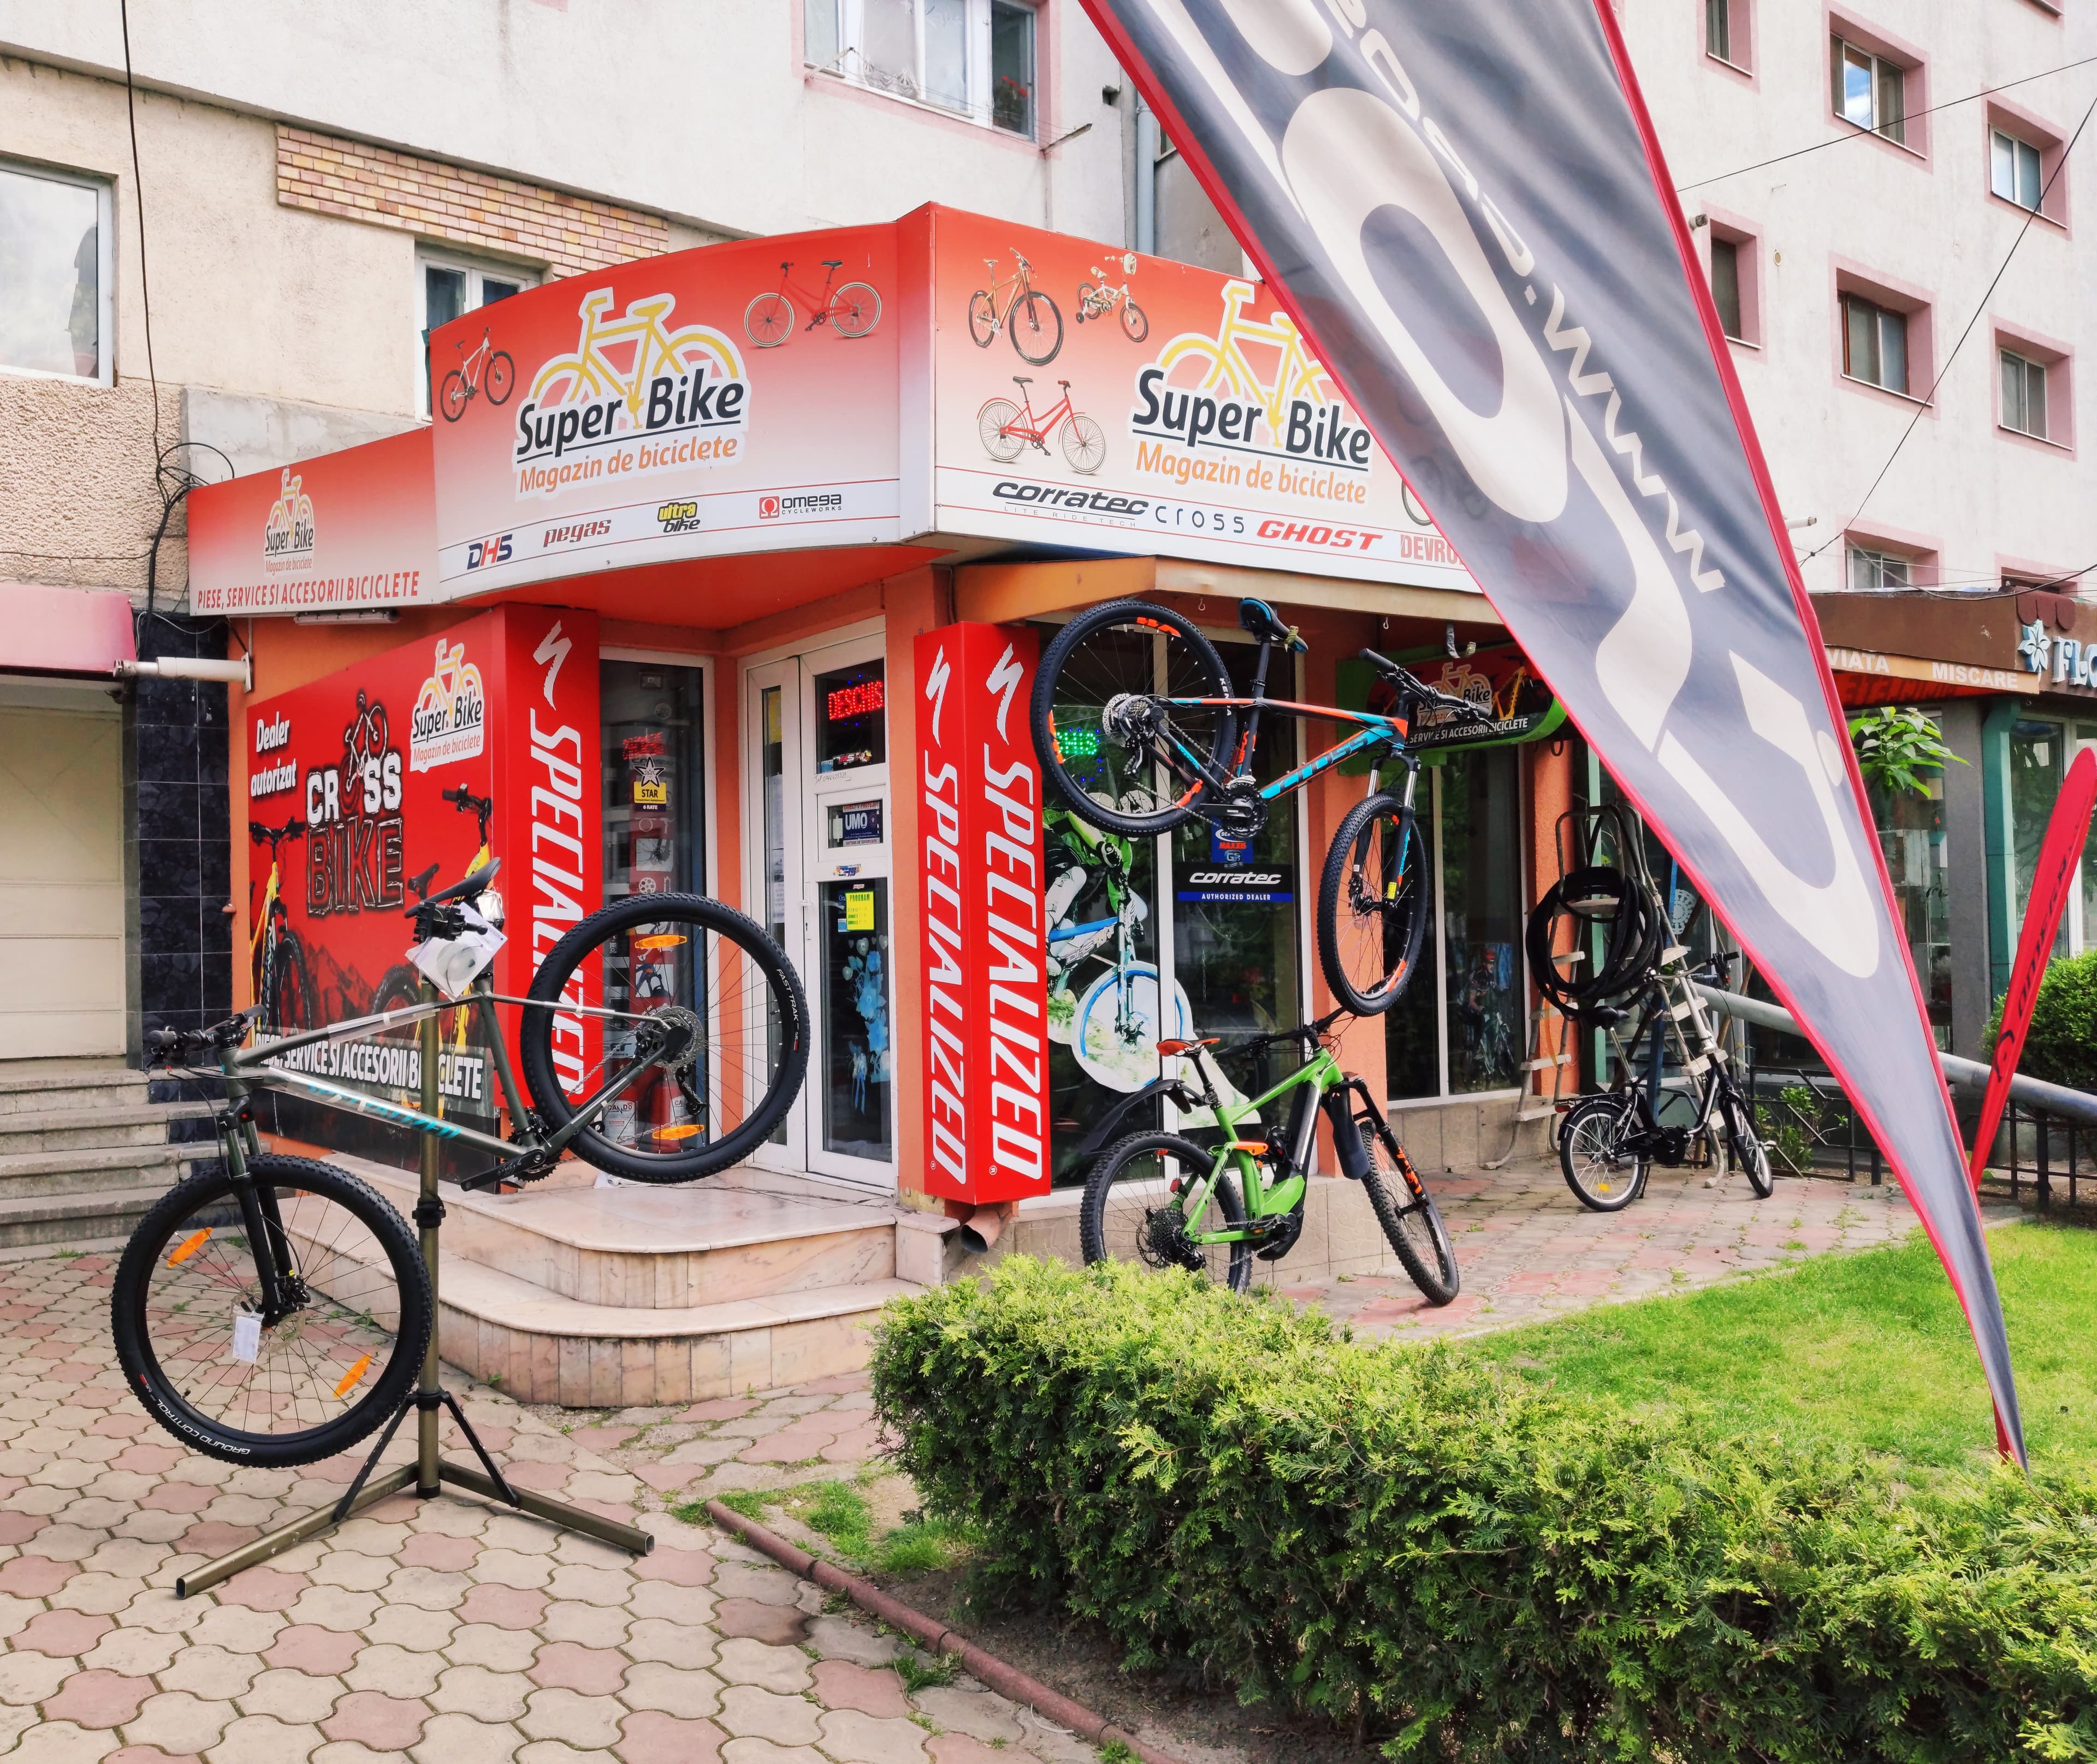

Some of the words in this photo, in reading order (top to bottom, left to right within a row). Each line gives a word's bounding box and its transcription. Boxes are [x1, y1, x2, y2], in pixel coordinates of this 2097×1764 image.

[517, 400, 622, 458] Super
[646, 368, 744, 430] Bike
[1133, 369, 1263, 447] Super
[1284, 400, 1371, 464] Bike
[520, 458, 600, 494] Magazin
[608, 448, 632, 474] de
[639, 436, 737, 468] biciclete
[1136, 441, 1241, 485] Magazin
[1246, 455, 1272, 490] de
[1278, 458, 1367, 504] biciclete
[657, 502, 698, 522] ultra
[782, 493, 842, 509] omega
[782, 506, 843, 515] CYCLEWORKS
[992, 482, 1150, 515] corratec
[543, 519, 612, 548] pegas
[663, 518, 701, 533] bike
[1004, 506, 1039, 515] LITE
[1053, 512, 1088, 522] RIDE
[1099, 518, 1136, 528] TECH
[265, 525, 289, 557] Super
[294, 521, 313, 550] Bike
[466, 533, 513, 571] DHS
[1257, 520, 1384, 550] GHOST
[1401, 534, 1464, 565] DEVRO
[265, 559, 285, 576] Magazin
[286, 557, 292, 571] de
[292, 557, 312, 570] biciclete
[198, 589, 224, 609] PIESE,
[227, 585, 266, 608] SERVICE
[270, 584, 279, 605] SI
[282, 578, 343, 604] ACCESORII
[347, 571, 419, 601] BICICLETE
[1932, 661, 2018, 689] MISCARE
[828, 680, 884, 720] DESCHIS
[1219, 678, 1231, 716] KENA
[1463, 684, 1490, 703] Bike
[256, 711, 290, 753] Dealer
[413, 707, 447, 743] Super
[454, 691, 482, 728] Bike
[1441, 729, 1447, 739] SI
[413, 743, 441, 764] Magazin
[442, 740, 451, 755] de
[452, 734, 481, 753] biciclete
[251, 758, 297, 797] autorizat
[642, 789, 658, 798] STAR
[845, 812, 868, 830] UMO
[308, 816, 403, 915] BIKE
[1189, 871, 1282, 885] corratec
[925, 750, 967, 1185] SPECIALIZED
[984, 743, 1042, 1180] SPECIALIZED
[777, 969, 792, 992] FAST
[789, 994, 798, 1022] TRAK
[286, 1041, 328, 1073] SERVICE
[329, 1042, 340, 1077] SI
[341, 1043, 407, 1087] ACCESORII
[157, 1399, 200, 1437] CONTROL
[199, 1435, 251, 1455] GROUND
